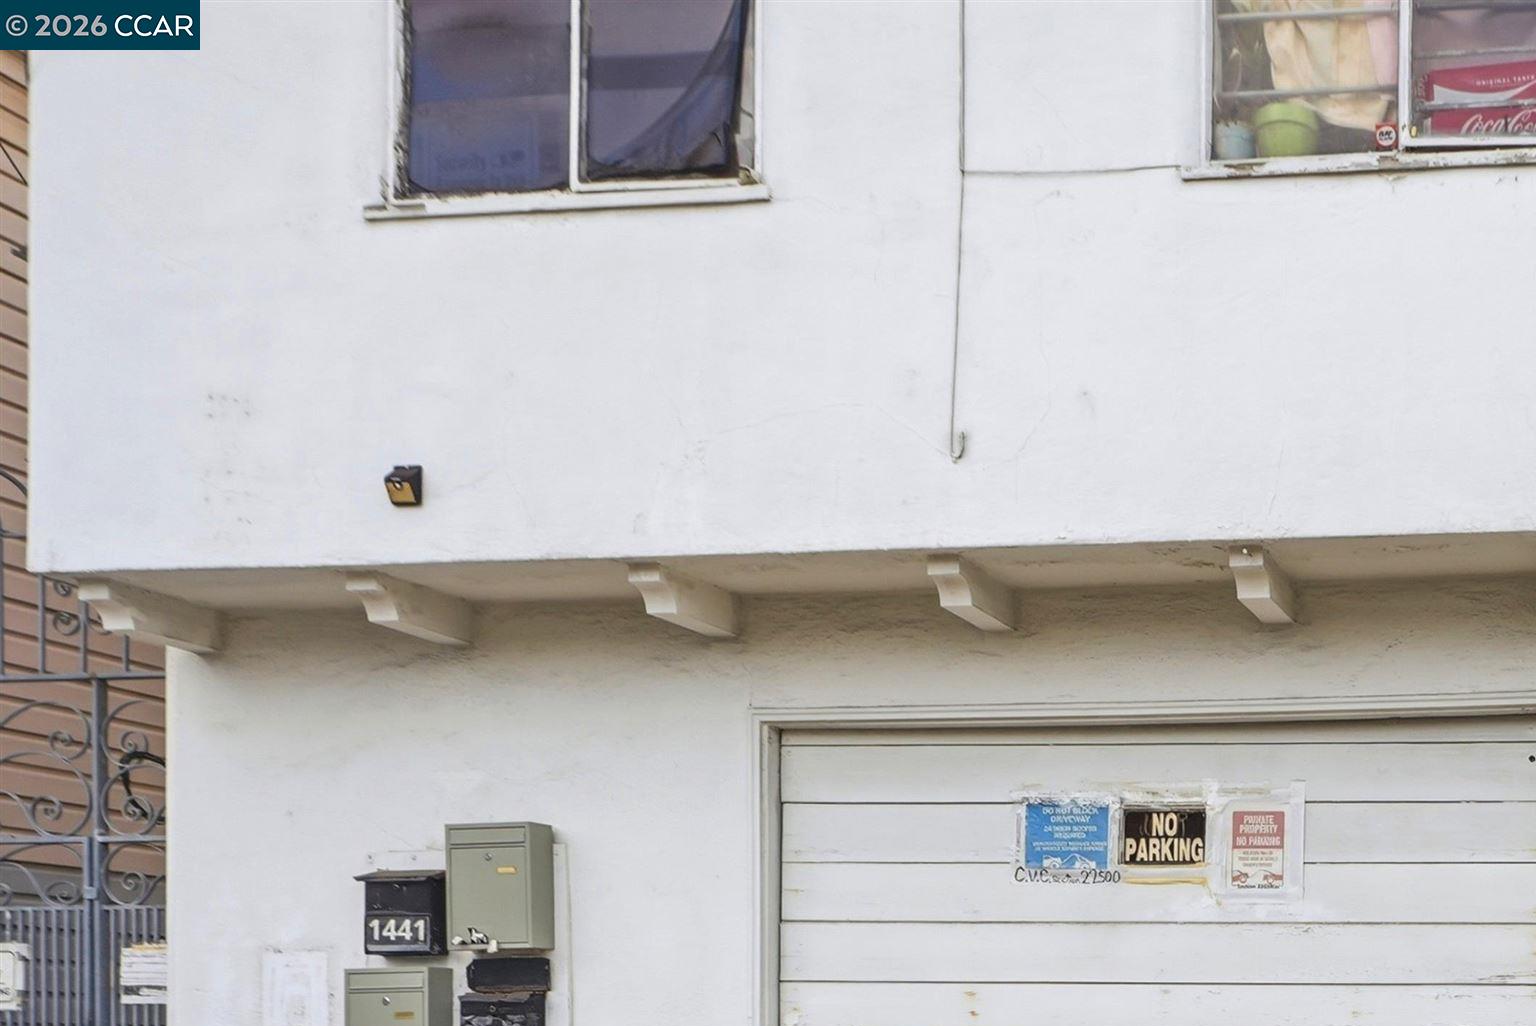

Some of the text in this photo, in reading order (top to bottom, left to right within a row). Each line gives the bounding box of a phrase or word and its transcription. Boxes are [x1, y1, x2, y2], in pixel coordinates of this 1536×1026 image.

[1151, 812, 1178, 837] NO
[1243, 815, 1275, 825] PRIVATE
[1239, 824, 1278, 834] PROPERTY
[1236, 836, 1281, 846] NO PARKING
[1125, 837, 1204, 862] PARKING
[1080, 868, 1121, 884] 22500
[368, 918, 425, 941] 1441
